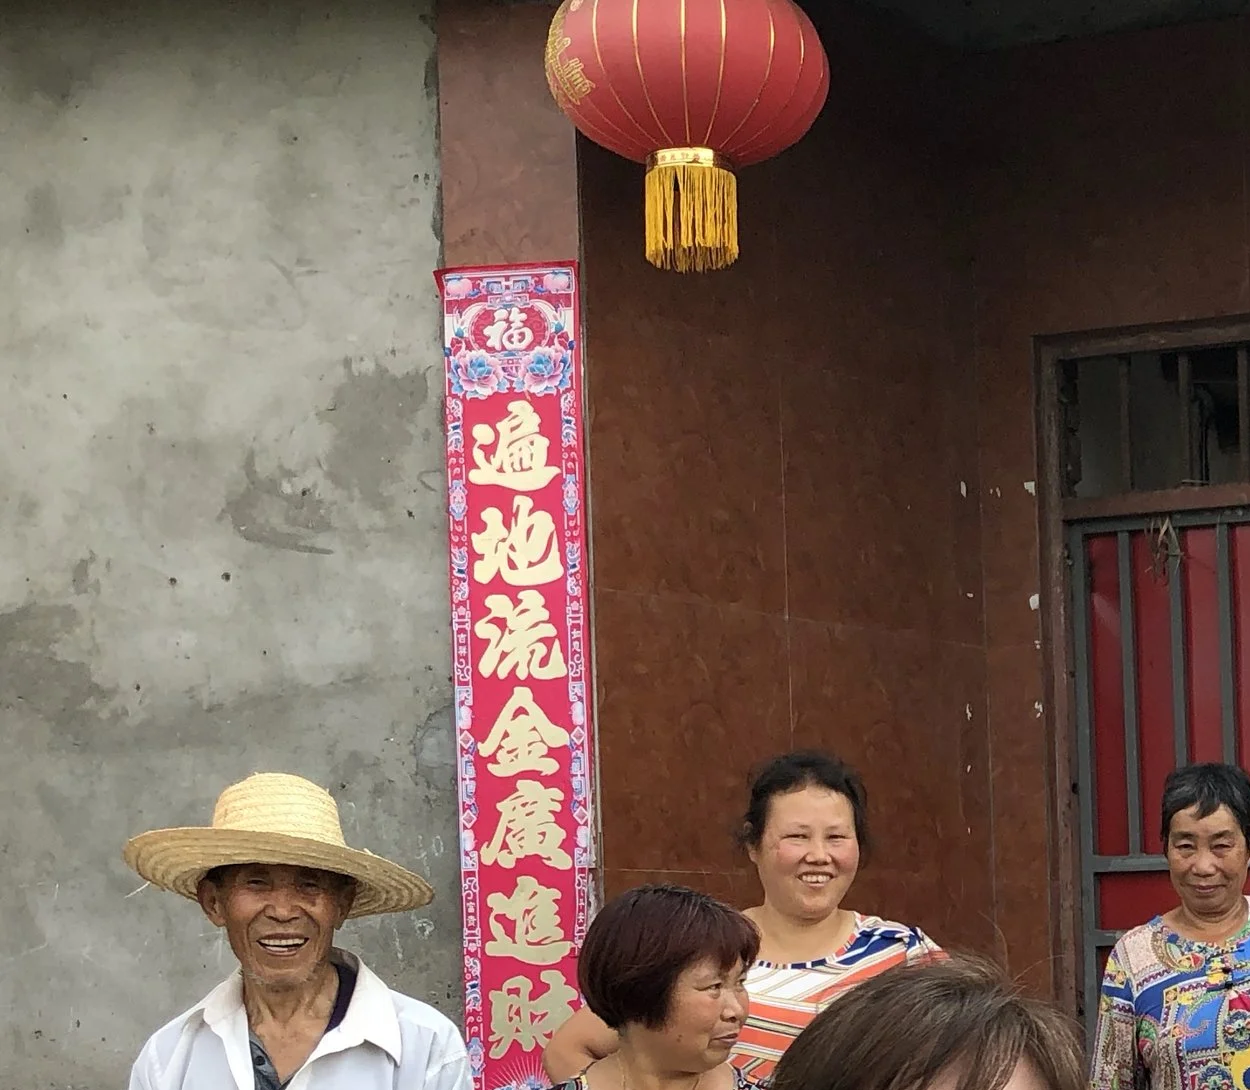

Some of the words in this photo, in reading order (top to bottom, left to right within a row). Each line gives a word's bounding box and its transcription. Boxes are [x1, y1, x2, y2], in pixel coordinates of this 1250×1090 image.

[482, 306, 535, 351] 福
[468, 400, 578, 1059] 遍地流金廣進財
